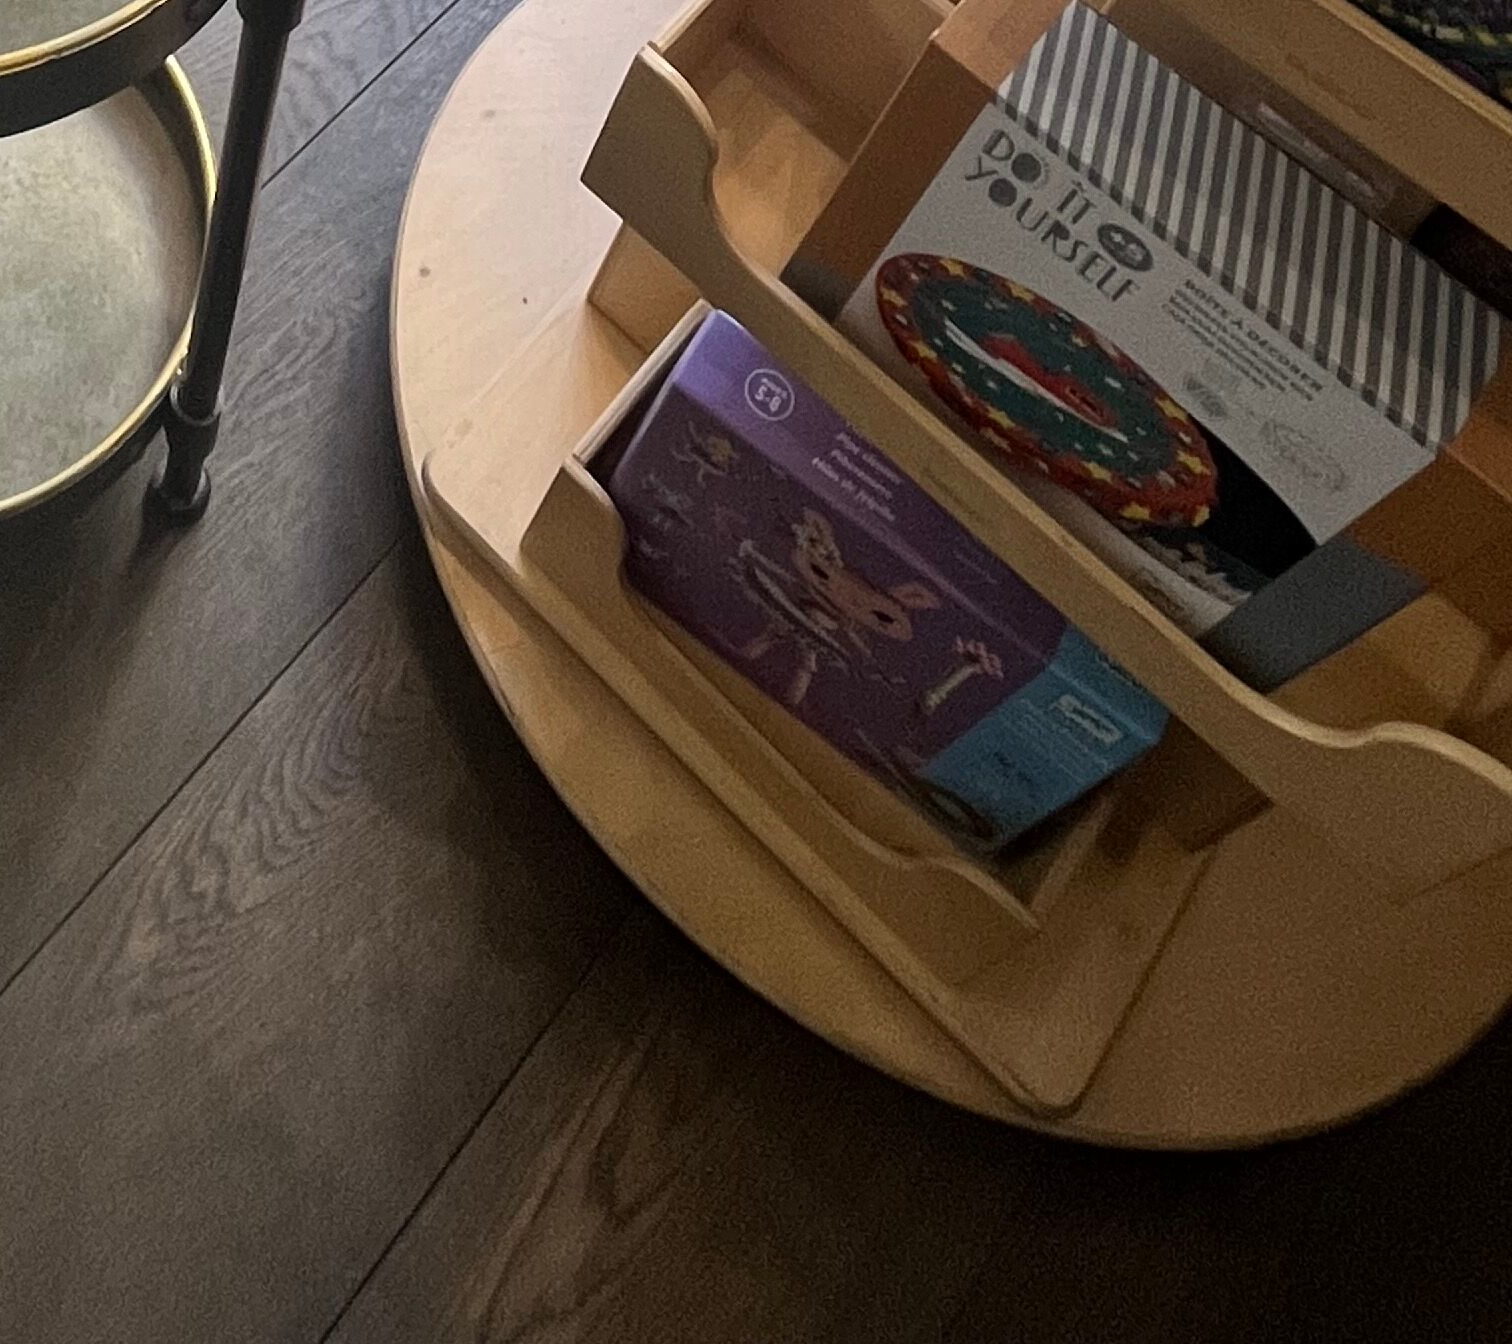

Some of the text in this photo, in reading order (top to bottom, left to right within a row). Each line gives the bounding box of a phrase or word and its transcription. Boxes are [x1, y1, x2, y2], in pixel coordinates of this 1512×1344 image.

[964, 154, 1141, 302] YOURSELF
[982, 128, 1096, 224] DO IT
